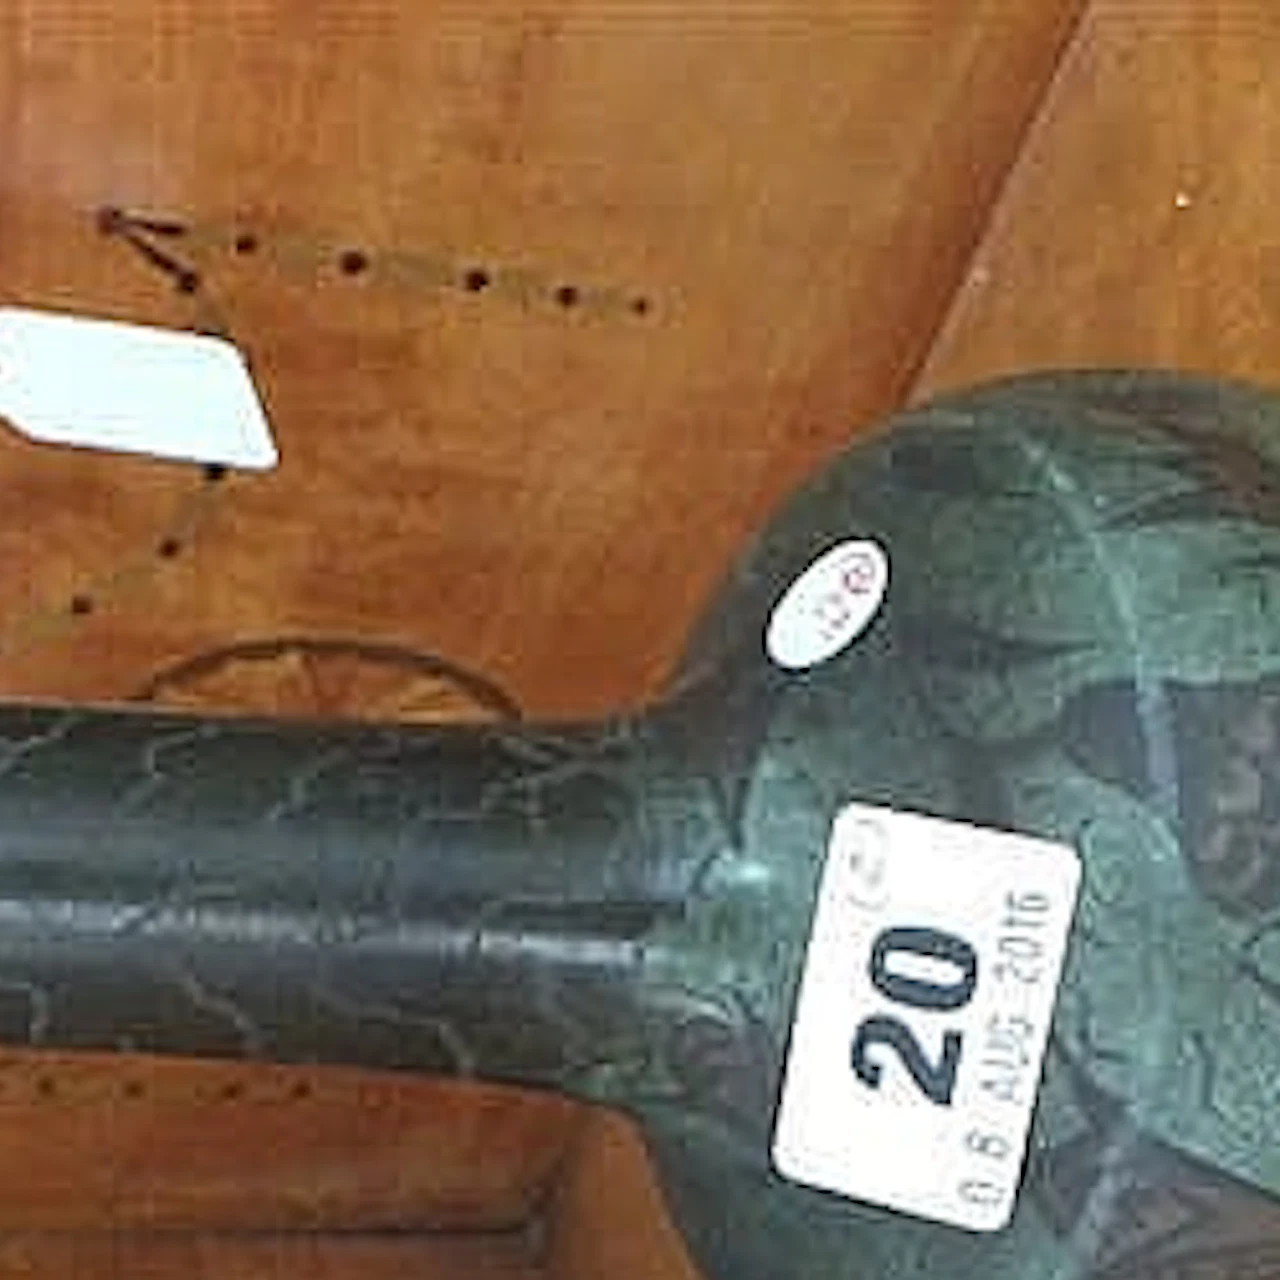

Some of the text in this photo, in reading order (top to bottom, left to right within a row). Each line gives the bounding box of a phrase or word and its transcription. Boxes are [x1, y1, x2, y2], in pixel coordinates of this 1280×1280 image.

[995, 890, 1050, 984] 2016
[850, 926, 978, 1107] 20
[980, 1012, 1035, 1105] AUG
